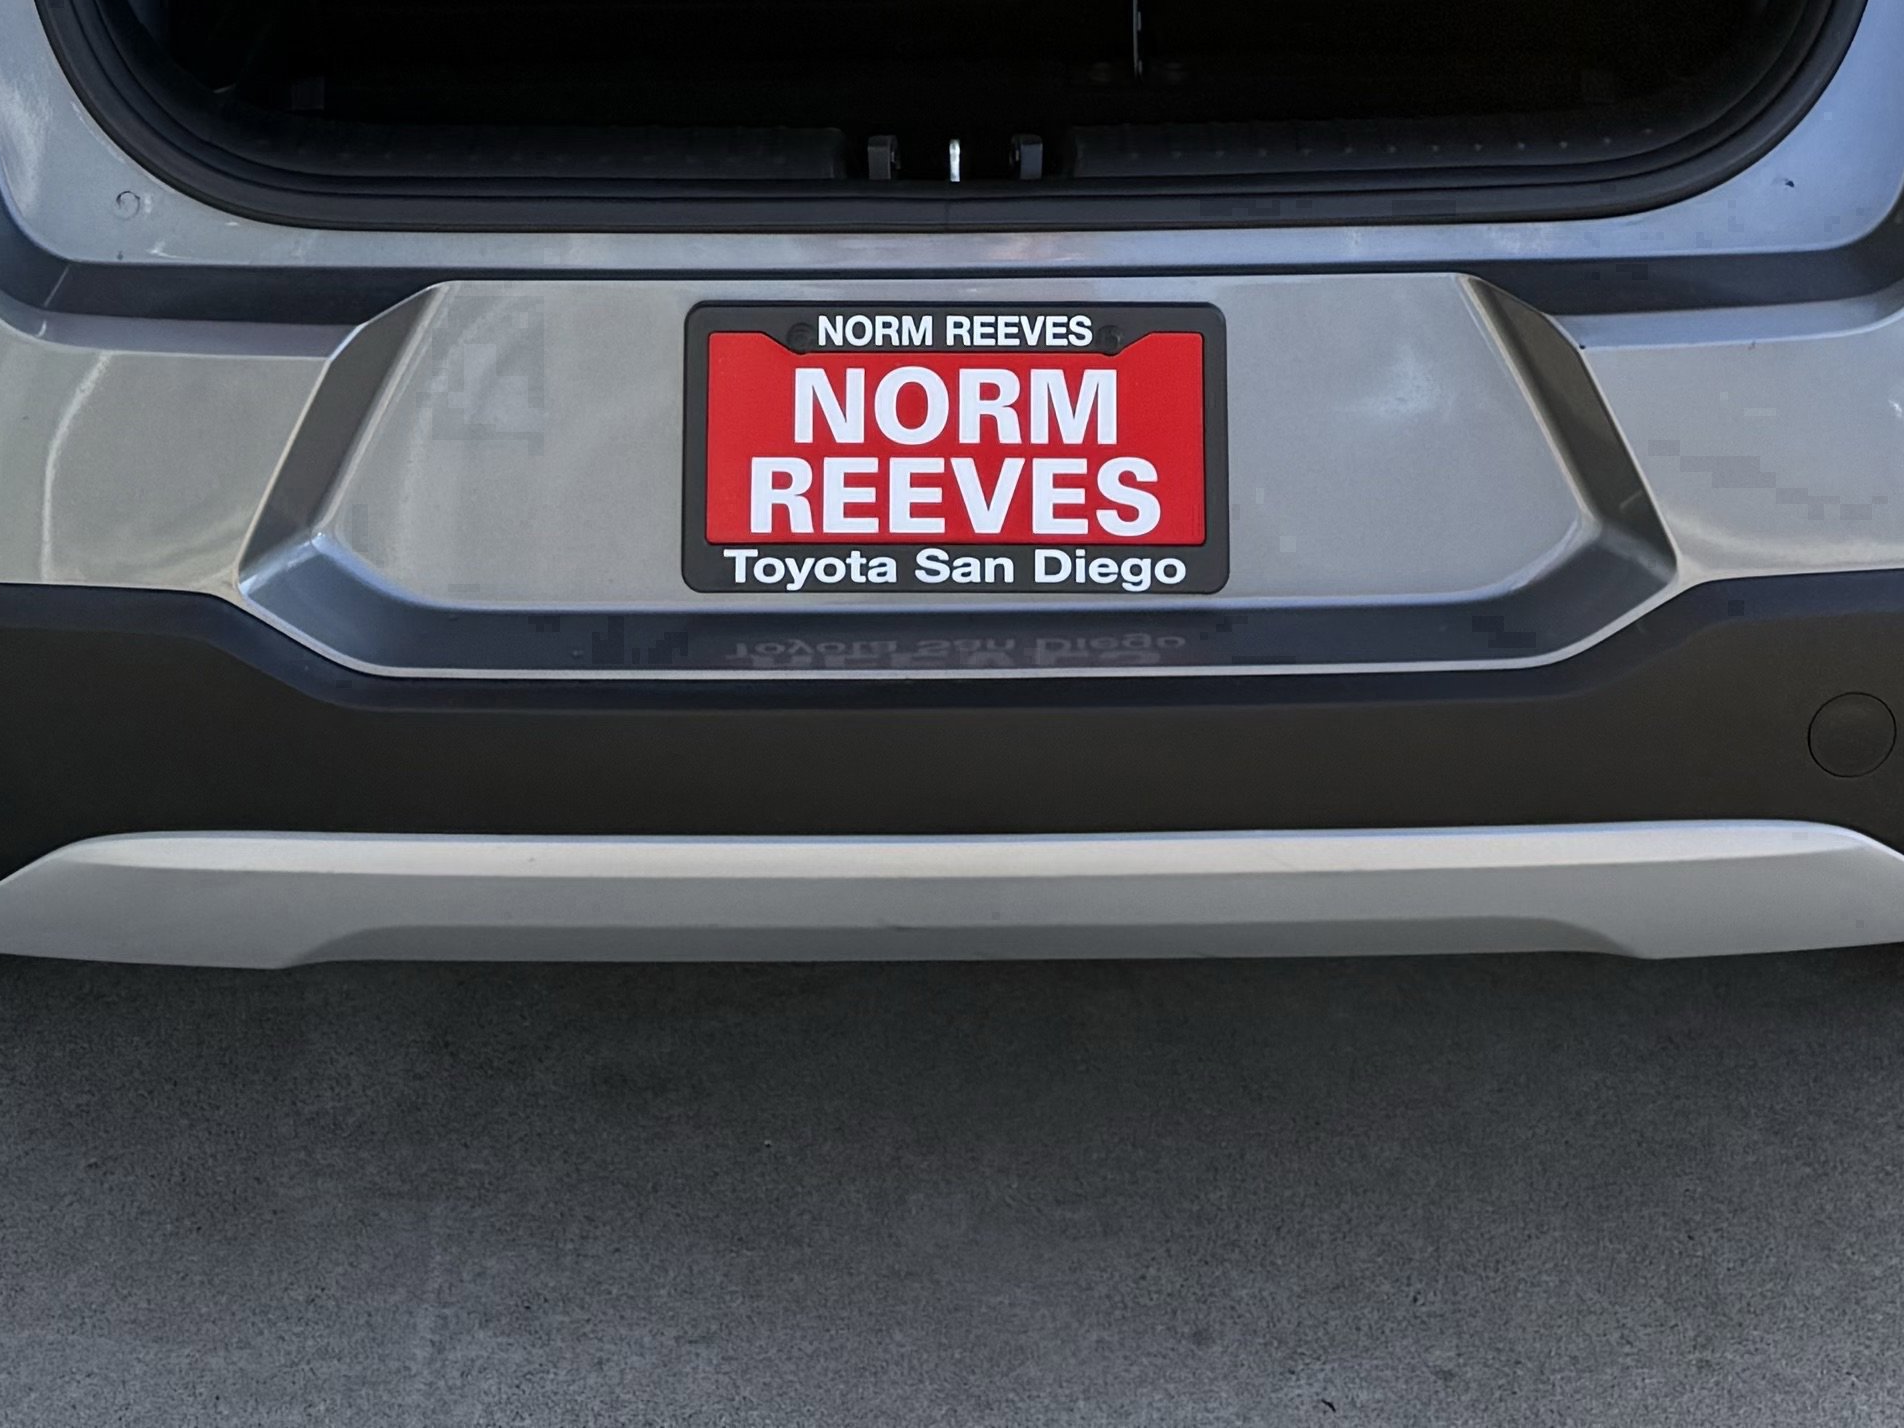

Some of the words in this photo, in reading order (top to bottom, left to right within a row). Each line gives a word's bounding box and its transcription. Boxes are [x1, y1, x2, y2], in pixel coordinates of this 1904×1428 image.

[817, 315, 934, 347] NORM
[946, 315, 1094, 347] REEVES
[794, 366, 1118, 445] NORM
[749, 457, 1162, 537] REEVES
[723, 548, 898, 592] Toyota
[914, 548, 1015, 585] San
[1034, 548, 1187, 592] Diego
